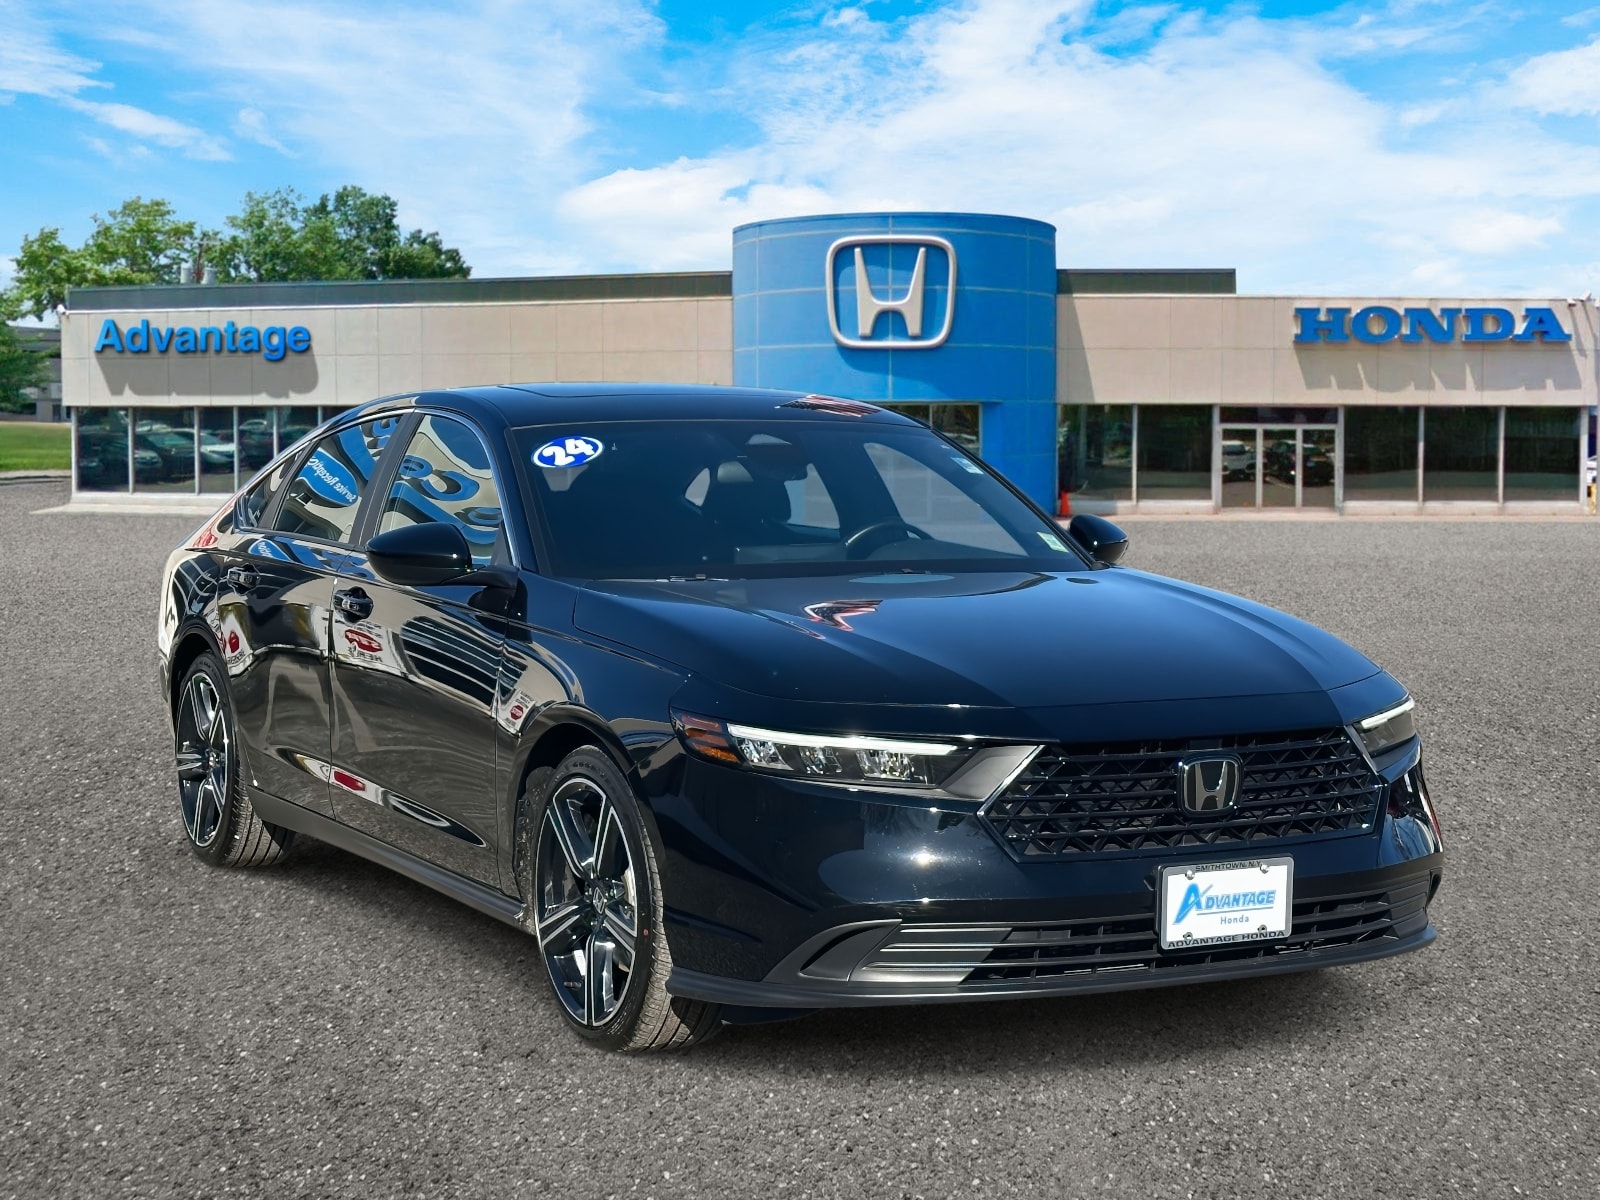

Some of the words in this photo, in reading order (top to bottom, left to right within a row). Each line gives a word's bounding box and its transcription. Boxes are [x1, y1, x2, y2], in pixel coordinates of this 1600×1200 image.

[1294, 306, 1572, 342] HONDA
[94, 319, 311, 361] Advantage
[542, 438, 595, 465] 24
[1172, 883, 1276, 925] ADVANTAGE
[1220, 914, 1250, 925] Honda
[1167, 934, 1239, 949] ADVANTAGE
[1242, 930, 1286, 940] HONDA
